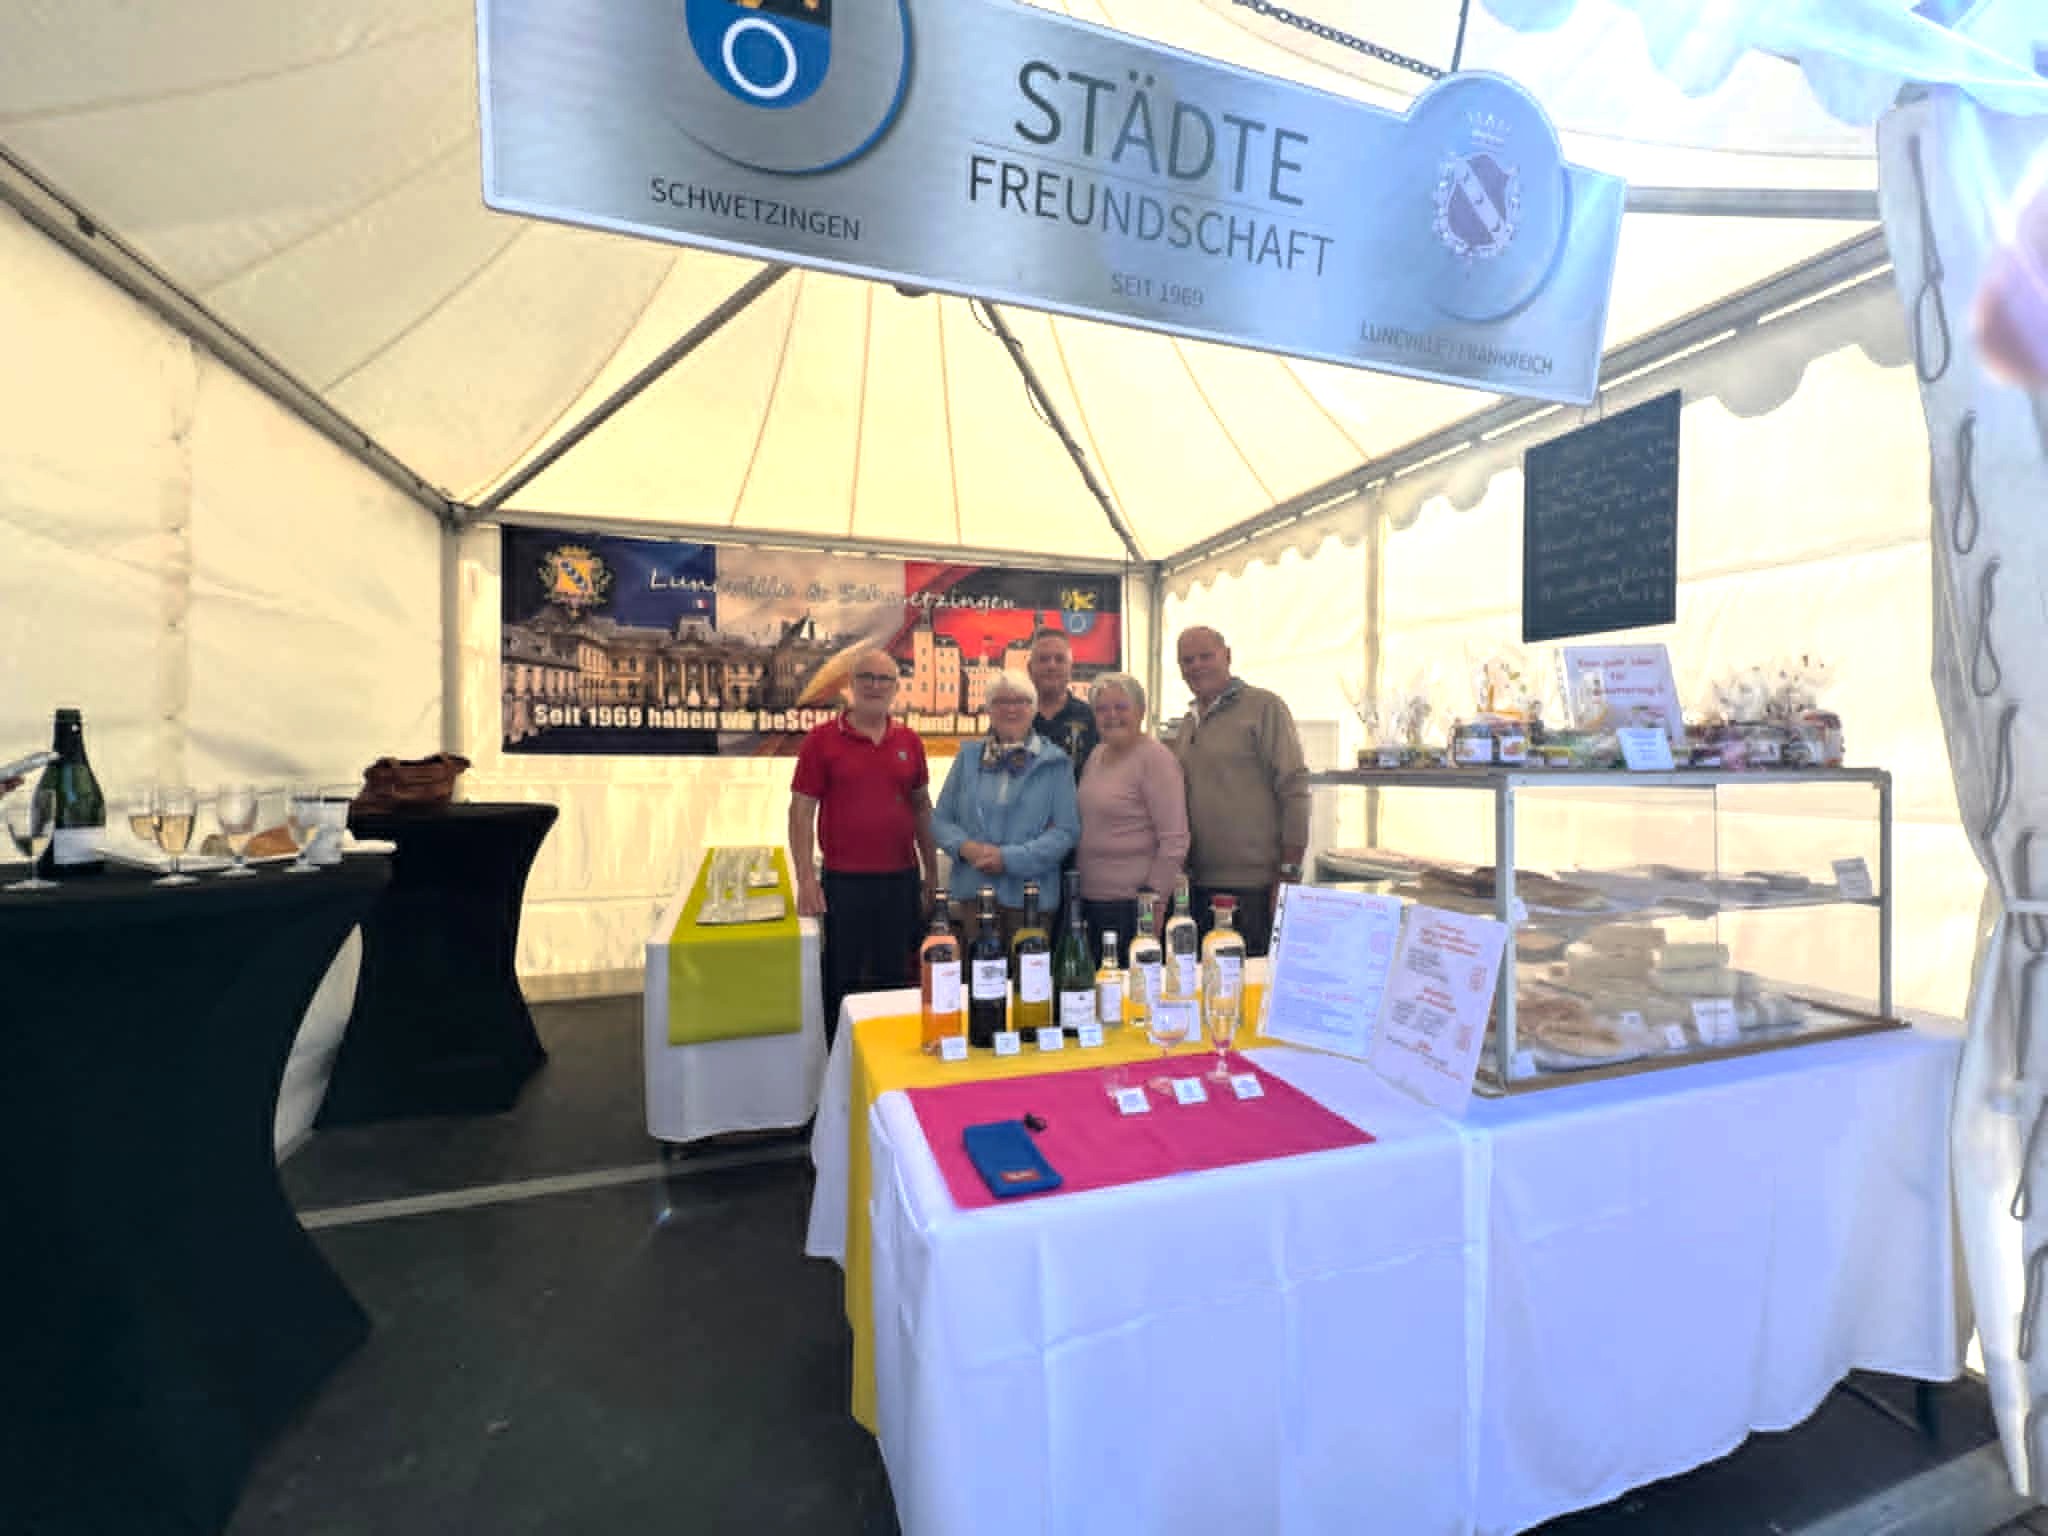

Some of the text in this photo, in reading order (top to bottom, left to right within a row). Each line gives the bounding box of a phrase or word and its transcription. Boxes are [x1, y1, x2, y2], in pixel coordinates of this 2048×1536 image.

[1014, 59, 1309, 206] STÄDTE
[651, 177, 861, 240] SCHWETZINGEN
[969, 155, 1335, 277] FREUNDSCHAFT
[1111, 272, 1152, 297] SEIT
[534, 704, 581, 727] Seit
[587, 706, 643, 728] 1969
[648, 706, 716, 729] haben
